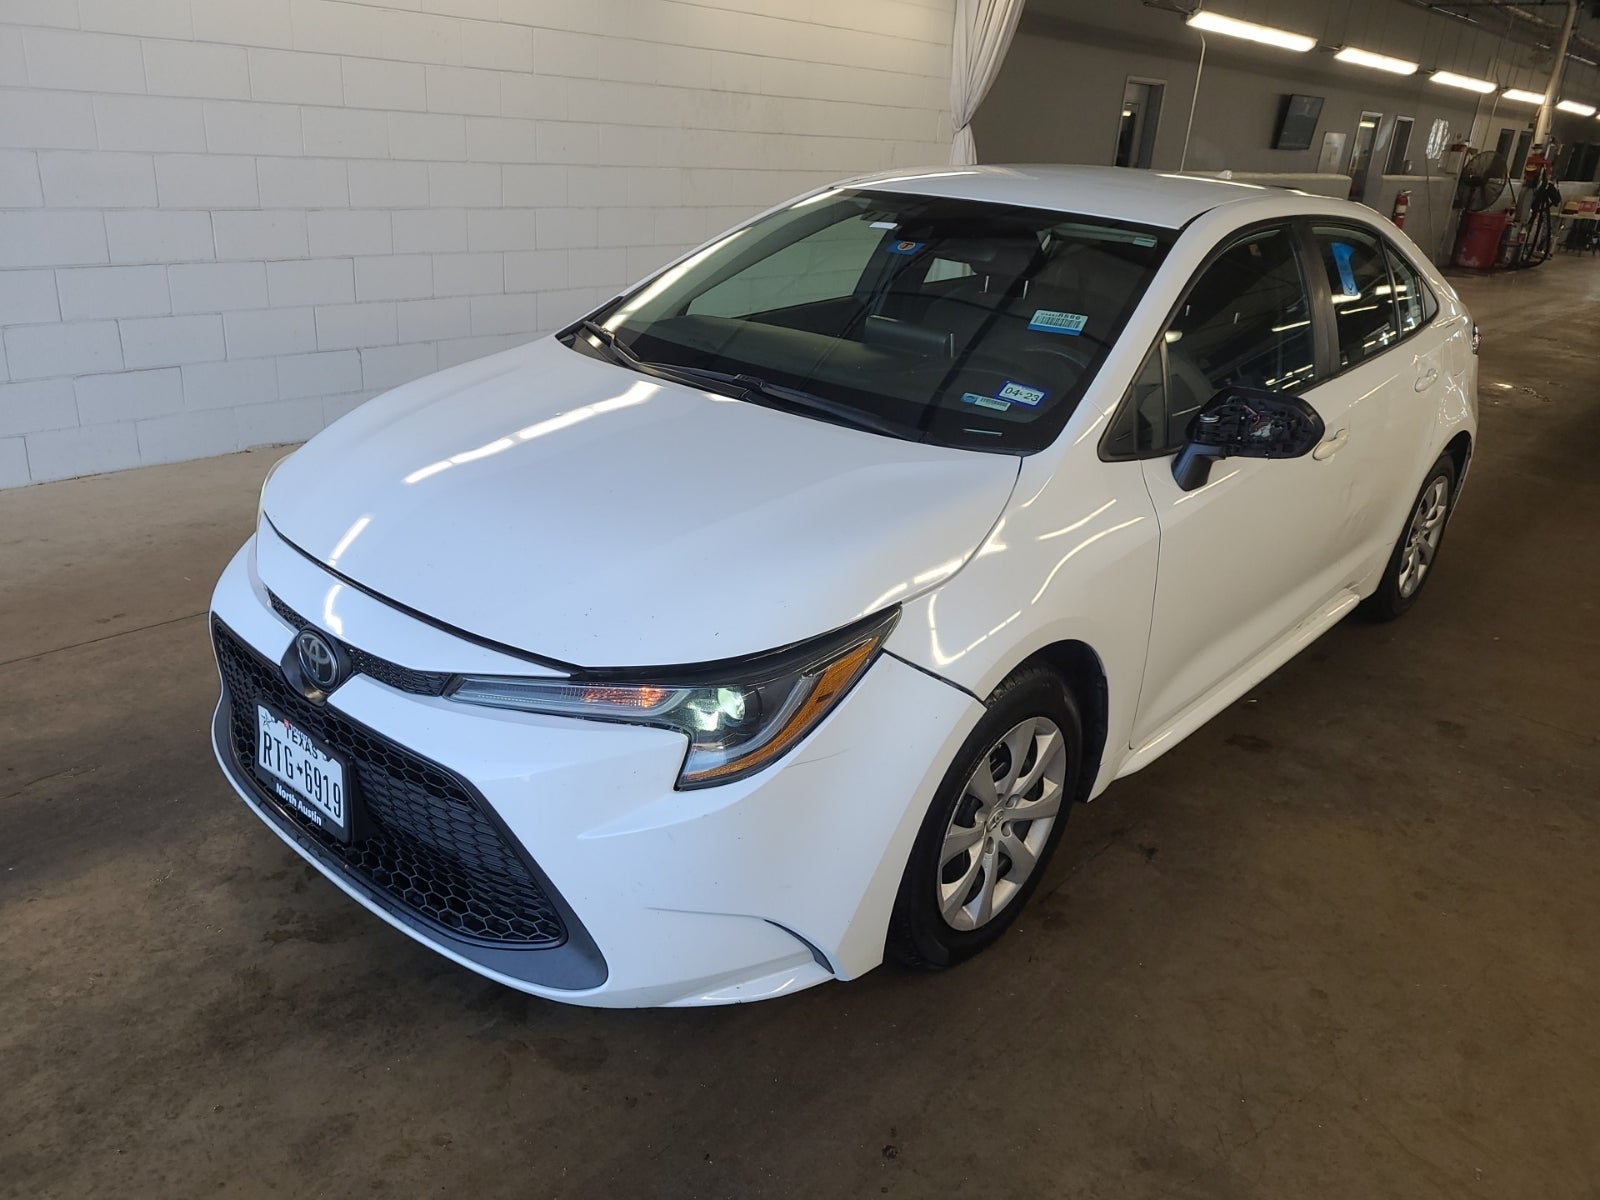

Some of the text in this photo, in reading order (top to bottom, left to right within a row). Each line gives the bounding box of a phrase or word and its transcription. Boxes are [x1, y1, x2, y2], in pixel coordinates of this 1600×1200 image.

[284, 722, 318, 760] TEXAS
[276, 782, 322, 826] North Austin
